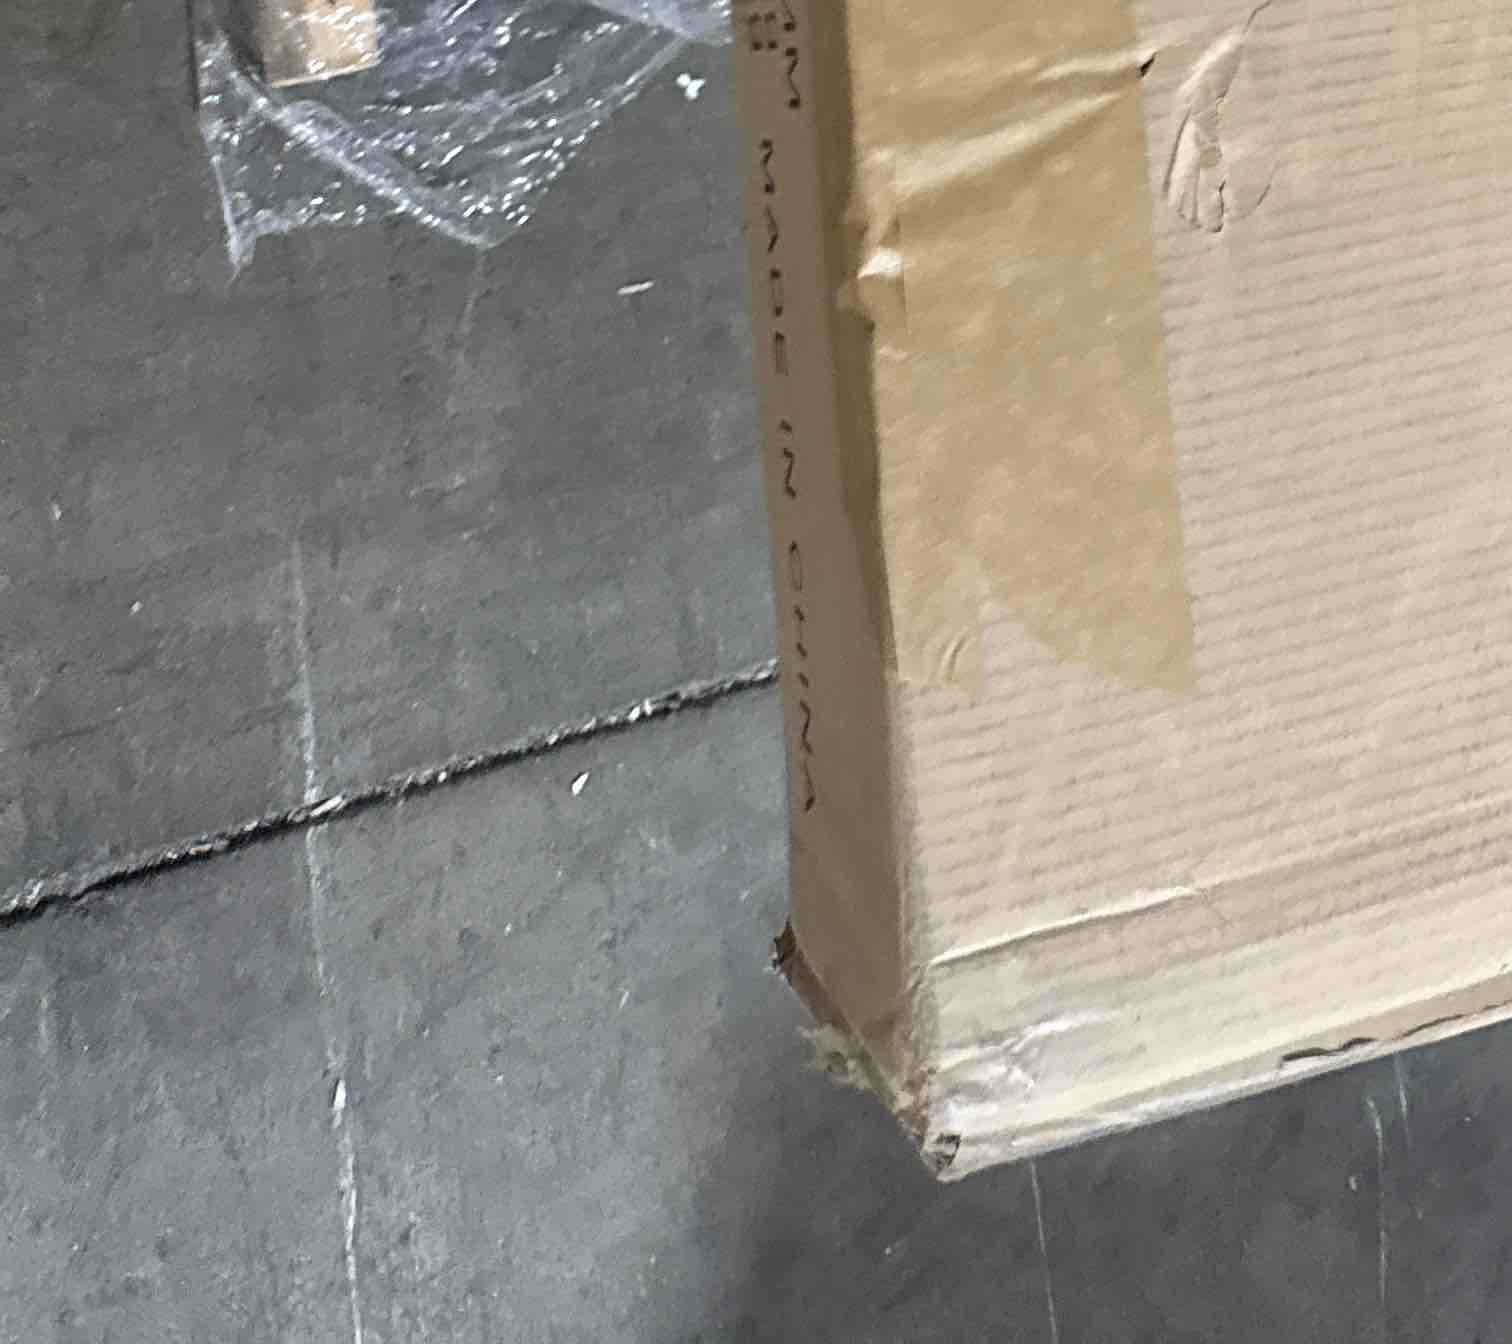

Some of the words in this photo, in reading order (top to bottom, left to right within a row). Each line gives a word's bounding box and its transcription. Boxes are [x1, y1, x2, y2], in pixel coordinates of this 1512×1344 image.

[759, 139, 789, 377] MADE
[780, 419, 797, 500] IN
[789, 540, 816, 813] CHINA
